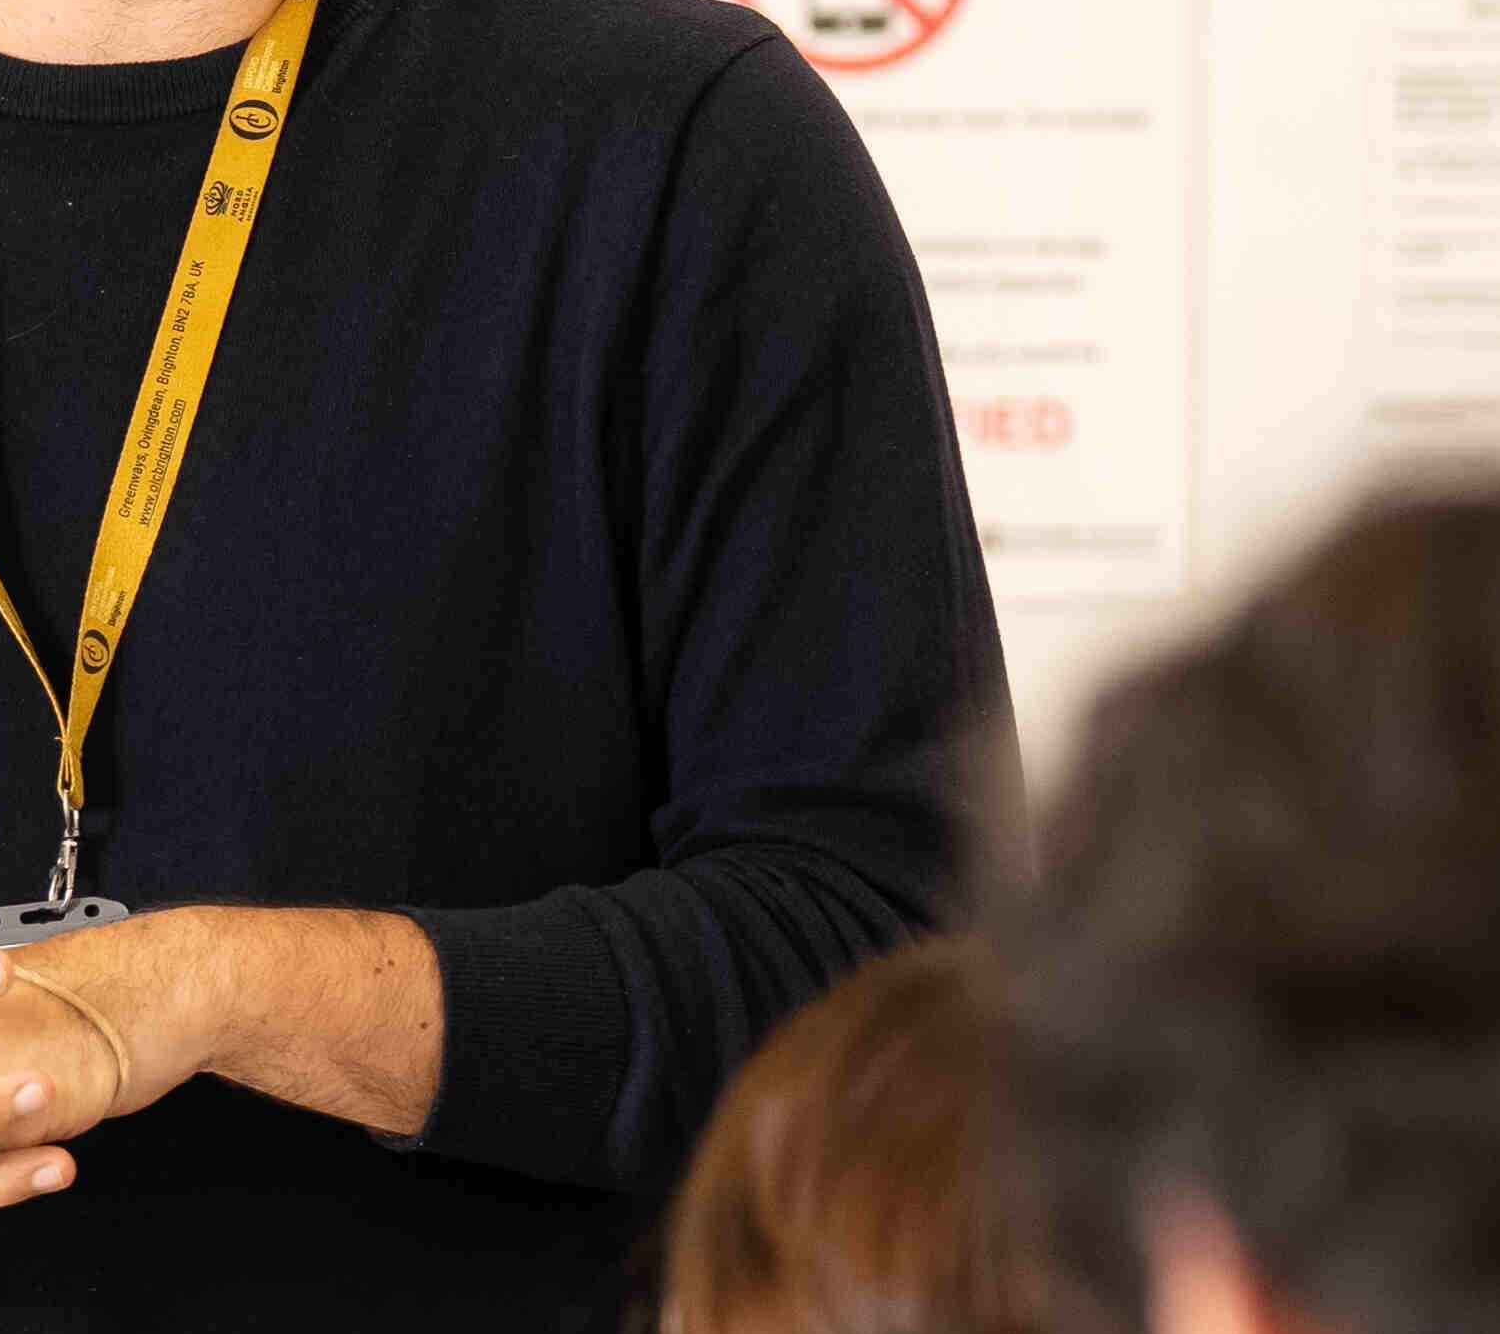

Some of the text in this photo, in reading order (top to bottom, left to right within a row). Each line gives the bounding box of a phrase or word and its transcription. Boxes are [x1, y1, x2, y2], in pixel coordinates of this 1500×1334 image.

[271, 59, 289, 94] Brighton
[118, 259, 206, 518] Greenways, Ovingdean, Brighton, BN2 7BA, UK
